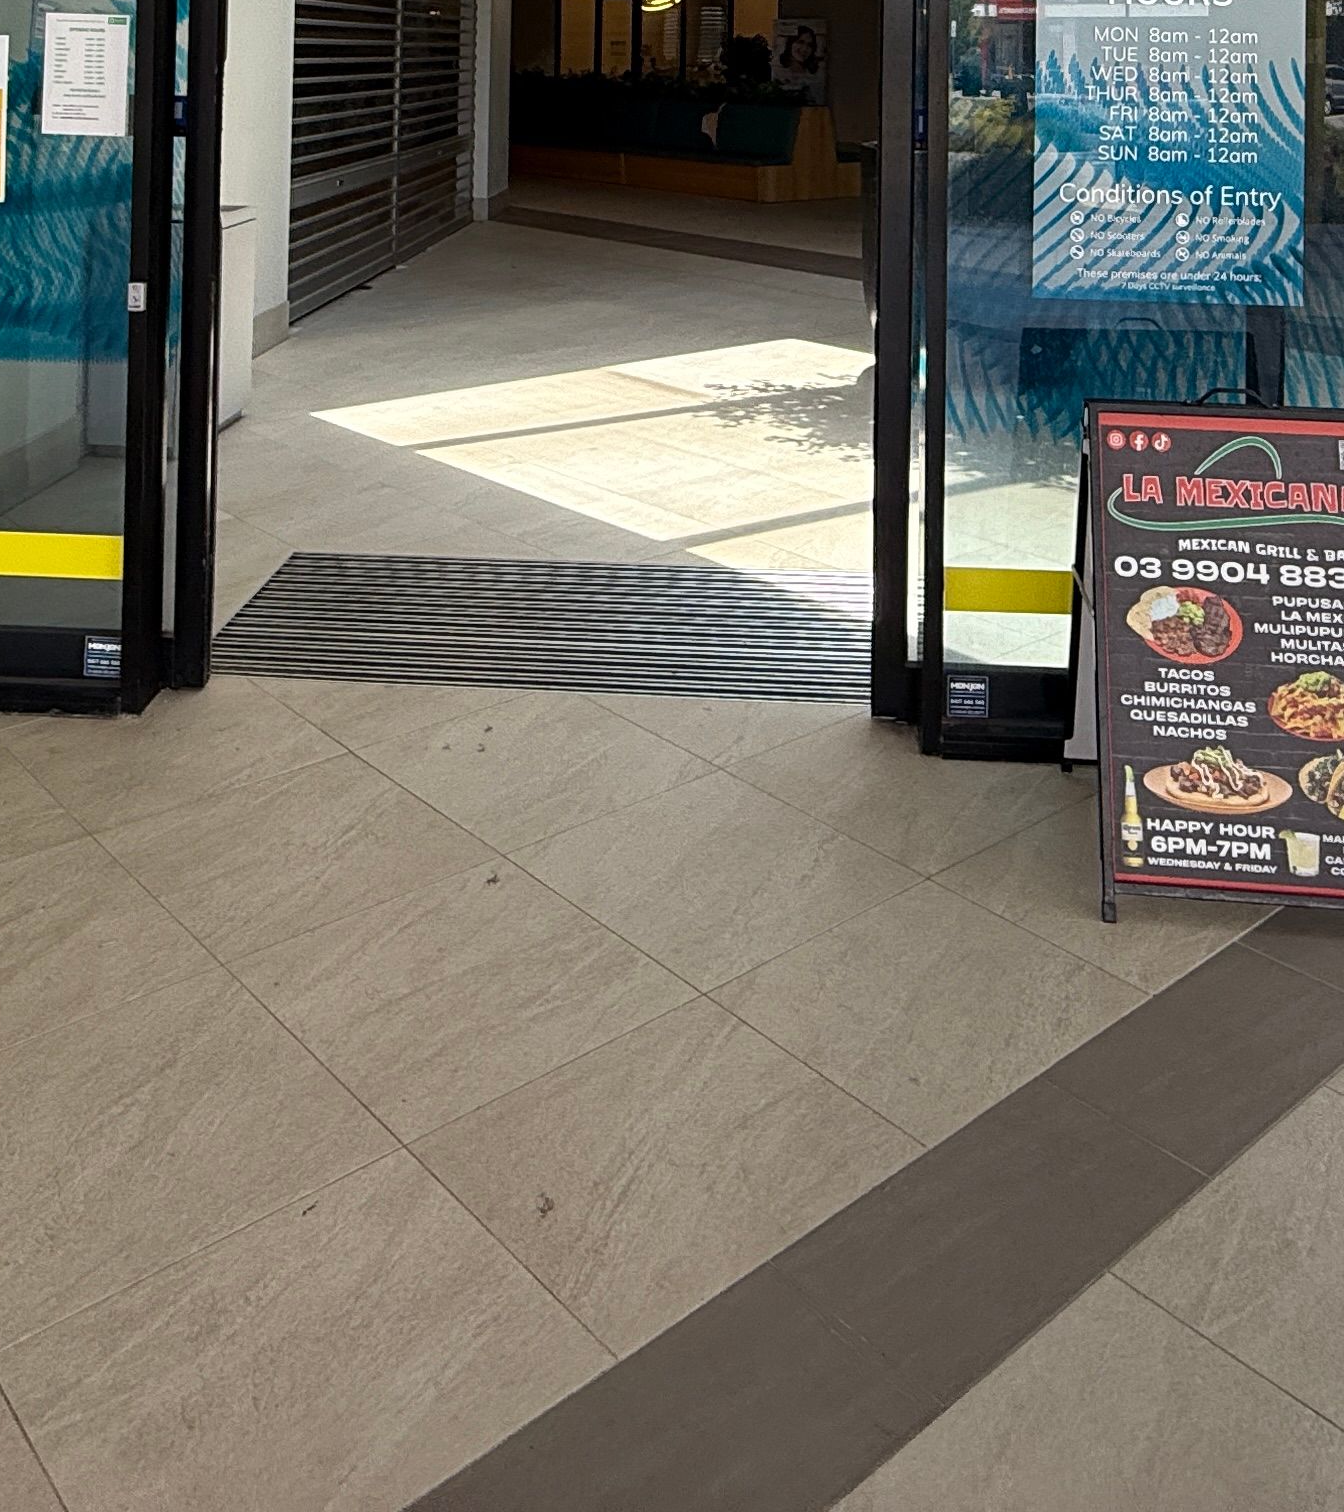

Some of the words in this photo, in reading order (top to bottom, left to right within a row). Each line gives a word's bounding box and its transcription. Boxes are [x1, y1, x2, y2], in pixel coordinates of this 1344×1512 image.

[1094, 26, 1139, 42] MON
[1148, 27, 1188, 43] 8am
[1208, 29, 1258, 44] 12am
[1101, 46, 1138, 62] TUE
[1148, 47, 1188, 63] 8am
[1208, 49, 1258, 64] 12am
[1091, 66, 1138, 82] WED
[1148, 67, 1188, 83] 8am
[1208, 69, 1258, 84] 12am
[1085, 85, 1138, 102] THUR
[1148, 86, 1188, 103] 8am
[1208, 88, 1258, 104] 12am
[1109, 106, 1138, 122] FRI
[1148, 107, 1188, 123] 8am
[1208, 109, 1258, 124] 12am
[1098, 125, 1136, 141] SAT
[1148, 126, 1188, 142] 8am
[1208, 128, 1258, 143] 12am
[1097, 145, 1138, 161] SUN
[1148, 146, 1188, 162] 8am
[1208, 148, 1258, 163] 12am
[1059, 182, 1182, 205] Conditions
[1190, 184, 1213, 205] of
[1221, 186, 1282, 212] Entry
[1077, 268, 1108, 278] These
[1111, 270, 1158, 282] premises
[1160, 272, 1178, 281] are
[1180, 271, 1211, 281] under
[1213, 272, 1227, 281] 24
[1123, 473, 1163, 504] LA
[1178, 538, 1250, 554] MEXICAN
[1256, 543, 1302, 559] GRILL
[1306, 548, 1319, 561] &
[1114, 555, 1162, 579] 03
[1171, 558, 1270, 585] 9904
[1281, 610, 1302, 621] LA
[1158, 667, 1215, 682] TACOS
[1144, 681, 1231, 697] BURRITOS
[1120, 694, 1257, 713] CHIMICHANGAS
[1130, 709, 1249, 727] QUESADILLAS
[1153, 725, 1227, 741] NACHOS
[1146, 818, 1214, 835] HAPPY
[1219, 822, 1276, 840] HOUR
[1151, 836, 1271, 861] 6PM-7PM
[1147, 856, 1221, 870] WEDNESDAY
[1223, 862, 1232, 871] &
[1235, 863, 1277, 874] FRIDAY
